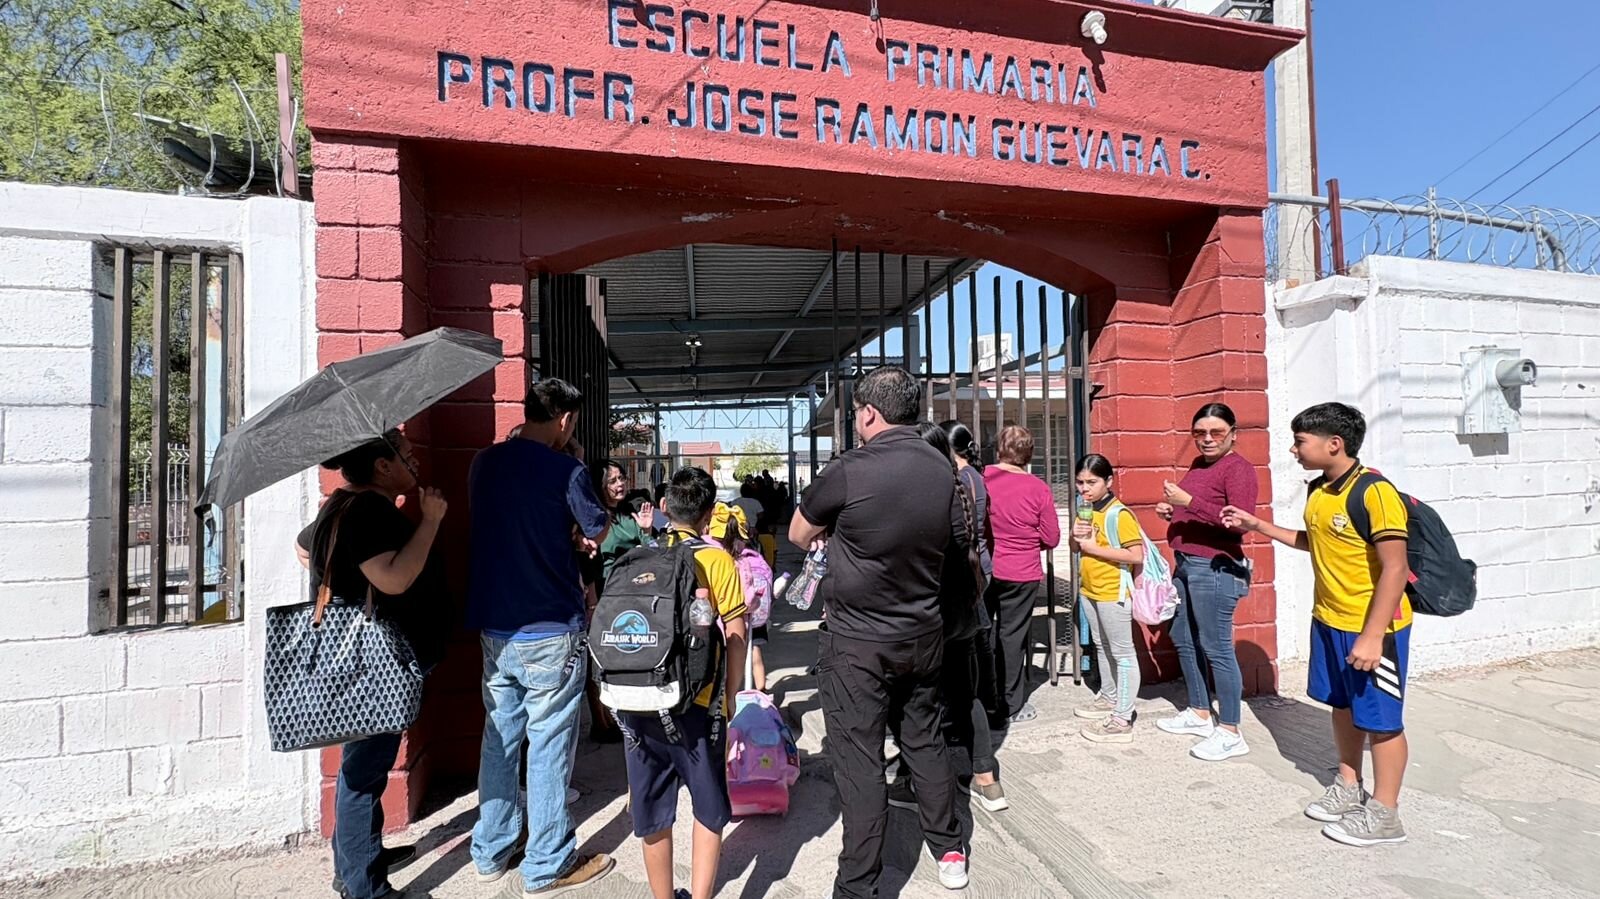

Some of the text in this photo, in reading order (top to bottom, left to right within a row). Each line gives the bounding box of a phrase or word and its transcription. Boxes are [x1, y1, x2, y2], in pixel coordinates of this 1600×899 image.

[607, 0, 1097, 108] ESCUELA PRIMARIA
[436, 51, 1213, 181] PROFR. JOSE RAMON GUEVARA C.
[631, 634, 656, 644] WORLD
